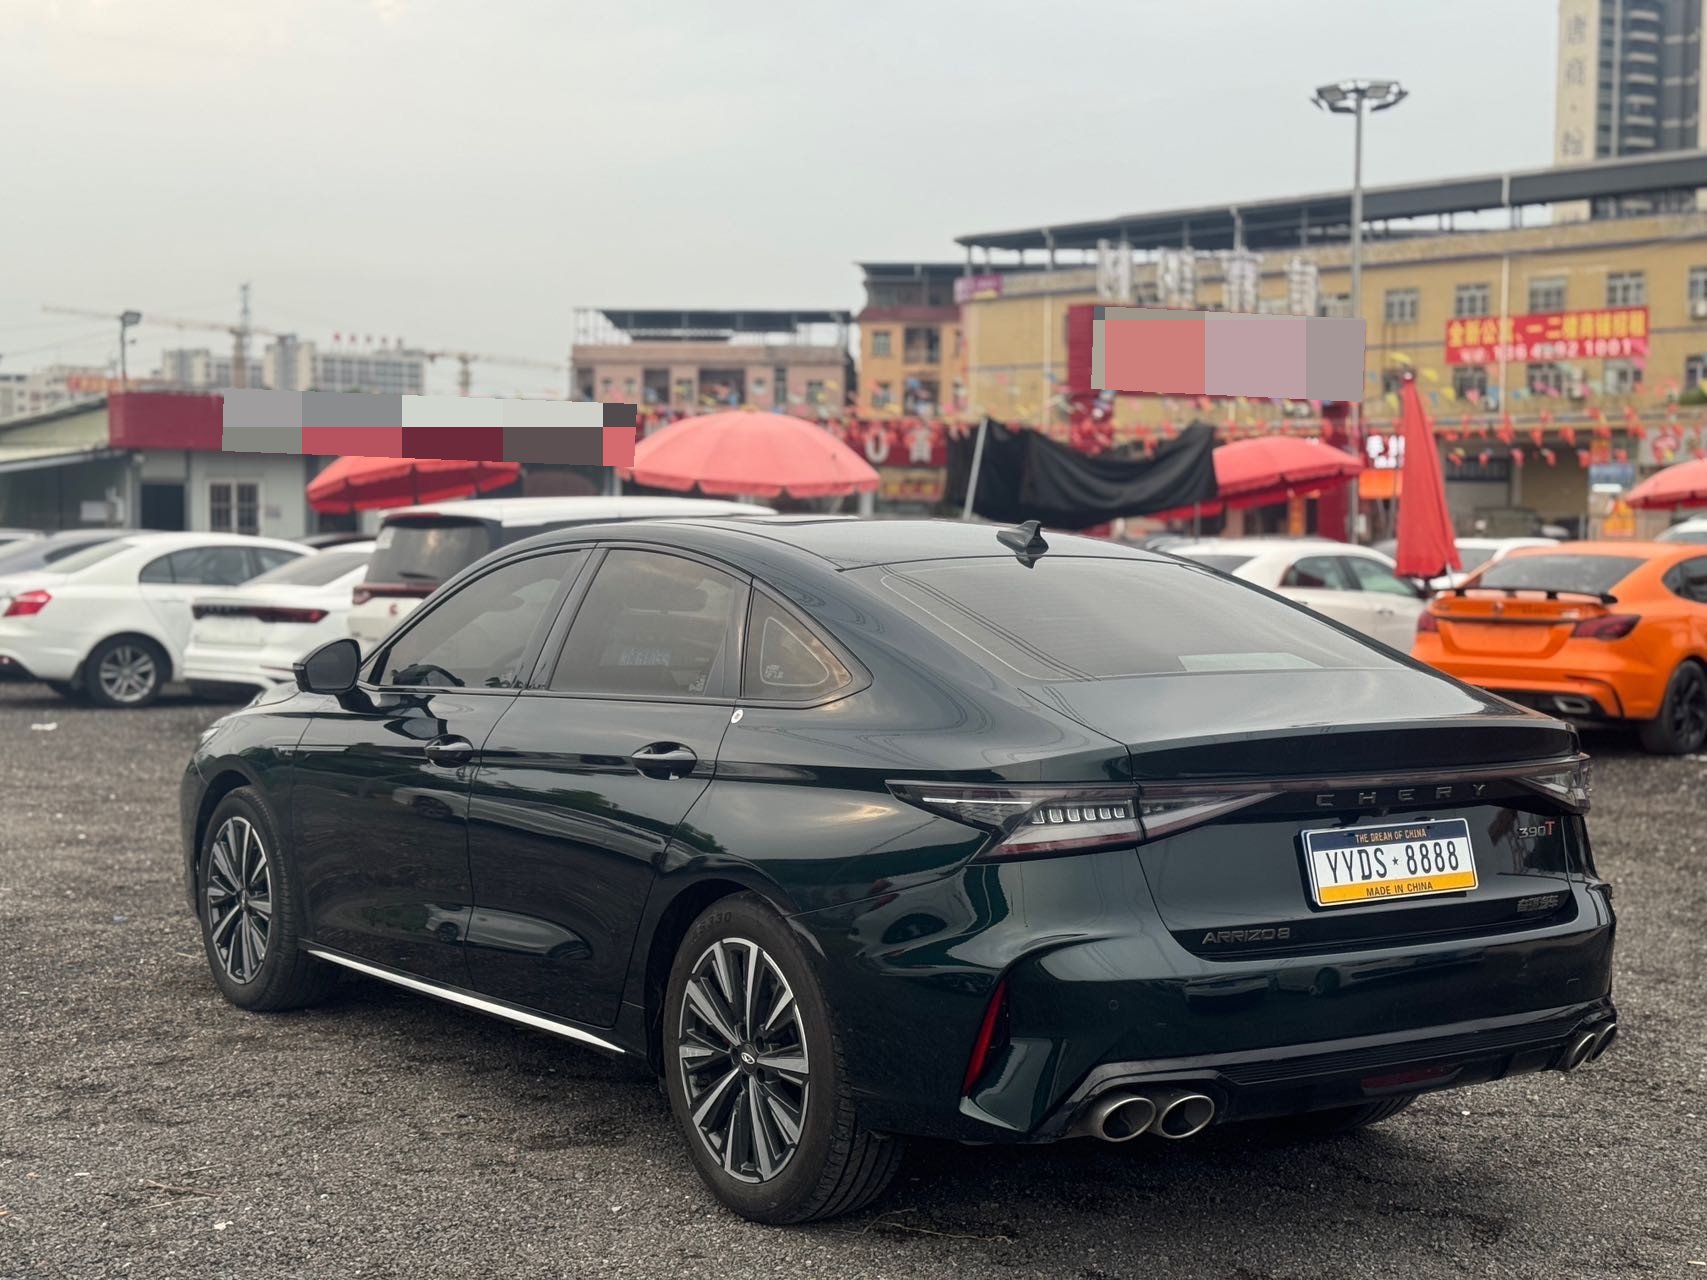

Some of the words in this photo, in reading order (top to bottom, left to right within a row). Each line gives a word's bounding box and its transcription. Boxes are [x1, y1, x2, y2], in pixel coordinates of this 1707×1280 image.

[1315, 783, 1486, 807] CHERY
[1355, 833, 1369, 843] THE
[1370, 832, 1393, 842] DREAM
[1394, 830, 1402, 840] OF
[1404, 828, 1427, 839] CHINA
[1518, 820, 1555, 839] 390T
[1325, 847, 1388, 884] YYDS
[1405, 840, 1459, 876] 8888
[1366, 884, 1391, 897] MADE
[1394, 883, 1404, 893] IN
[1407, 881, 1433, 892] CHINA
[1201, 928, 1275, 945] ARRIZO
